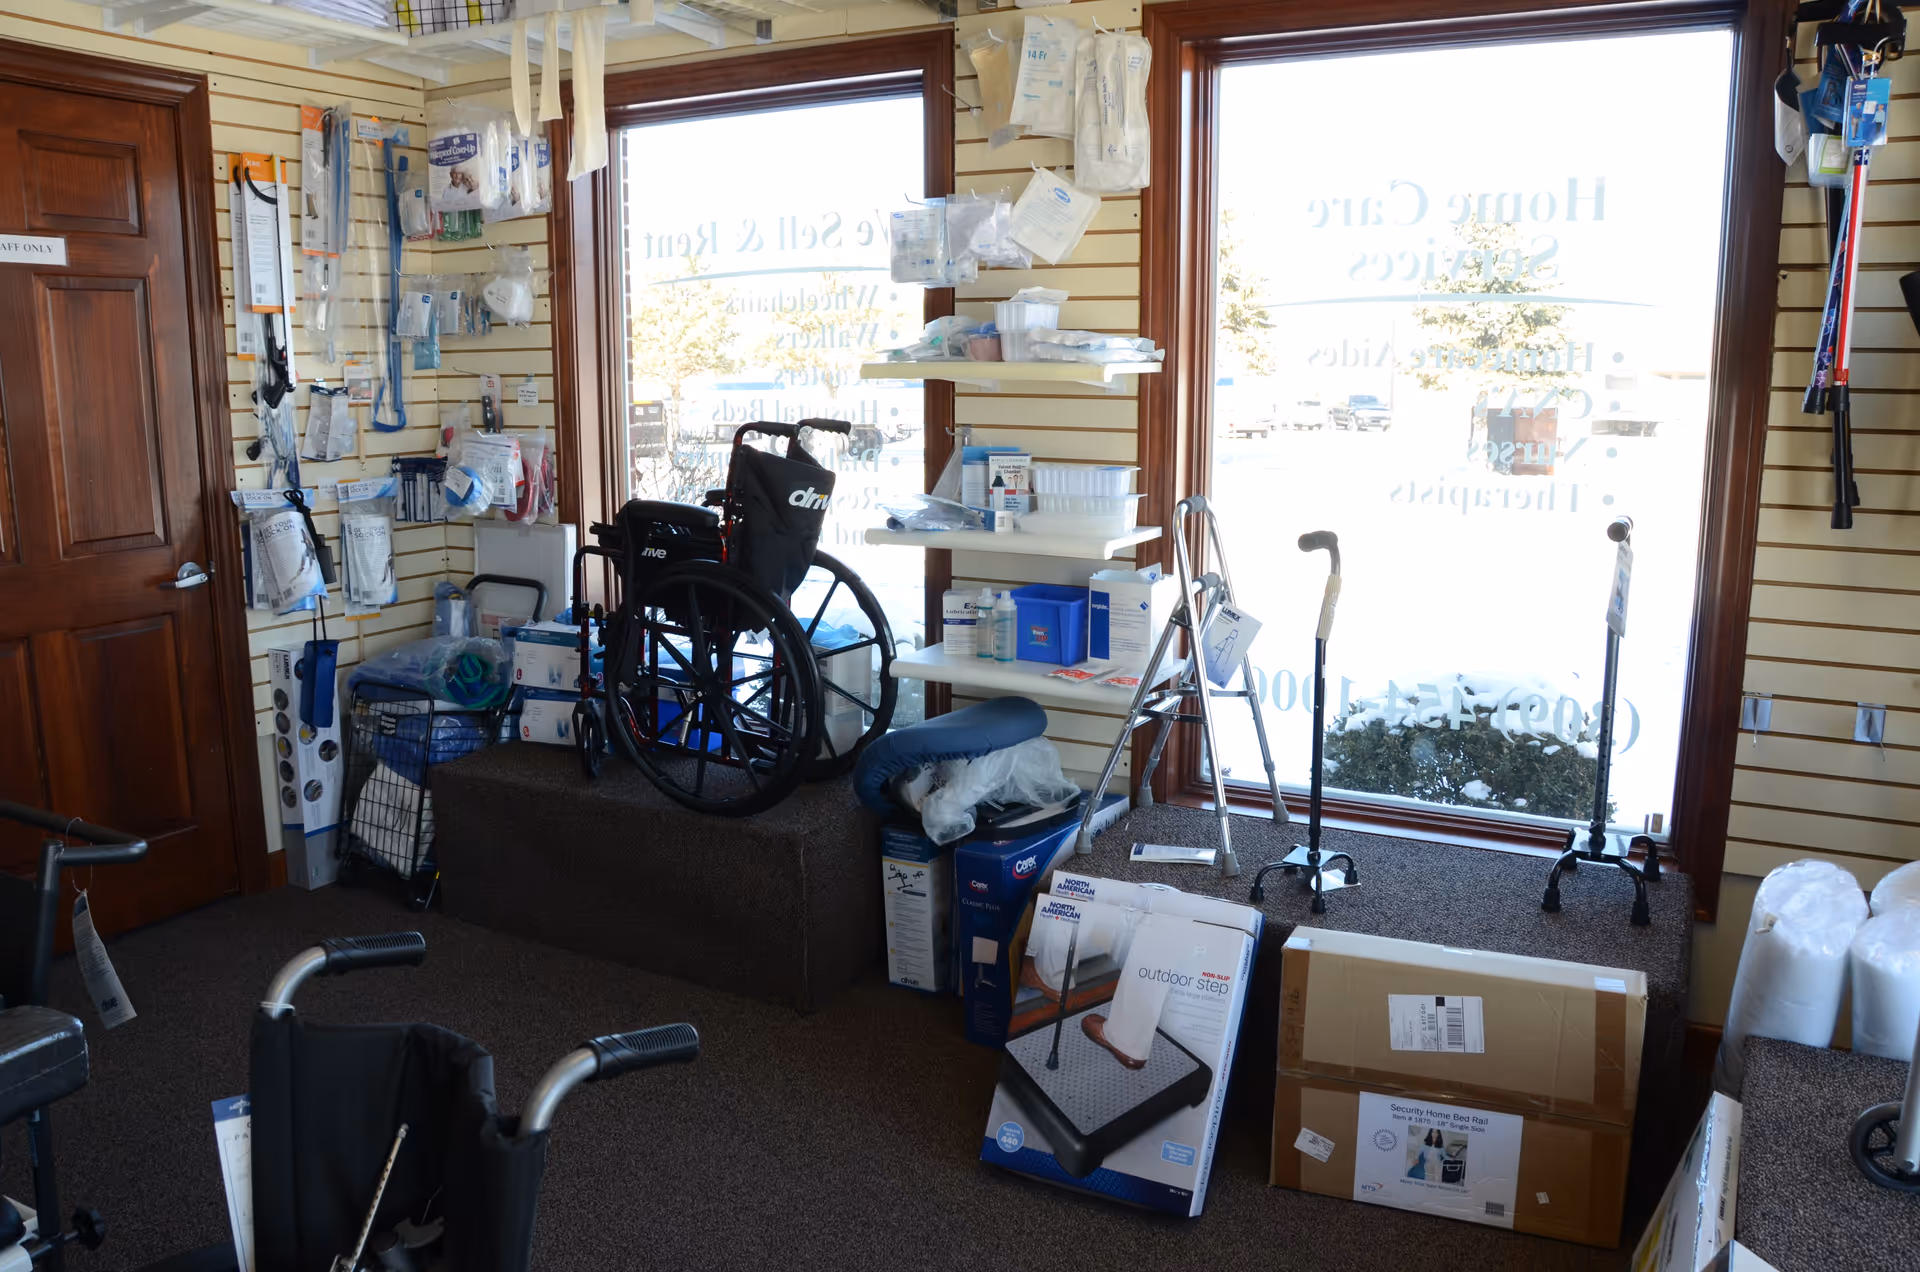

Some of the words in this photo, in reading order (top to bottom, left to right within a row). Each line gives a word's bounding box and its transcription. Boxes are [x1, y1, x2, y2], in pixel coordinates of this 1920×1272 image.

[1027, 50, 1037, 59] 14
[1039, 50, 1048, 60] Fr
[23, 243, 53, 254] ONLY
[788, 486, 833, 510] driv
[273, 518, 294, 530] YOUR
[283, 523, 296, 534] ON
[354, 531, 373, 539] SOCK
[641, 546, 667, 560] rive
[1221, 606, 1241, 623] LUMEX
[283, 654, 291, 680] LUMEX
[1015, 854, 1039, 873] Carex
[971, 880, 988, 890] Carex
[1065, 878, 1090, 888] NORTH
[1057, 883, 1095, 896] AMERICAN
[1050, 901, 1075, 911] NORTH
[1041, 906, 1081, 920] AMERICAN
[1138, 967, 1195, 988] outdoor
[1196, 978, 1229, 997] step
[1202, 971, 1231, 982] NON-SLIP
[1390, 1103, 1425, 1116] Security
[1426, 1109, 1451, 1120] Home
[1453, 1113, 1470, 1123] Bed
[1472, 1116, 1489, 1126] Rail
[1392, 1113, 1407, 1121] Item
[1414, 1117, 1432, 1125] 1875
[1449, 1123, 1469, 1131] Single
[1361, 1184, 1377, 1192] MTS
